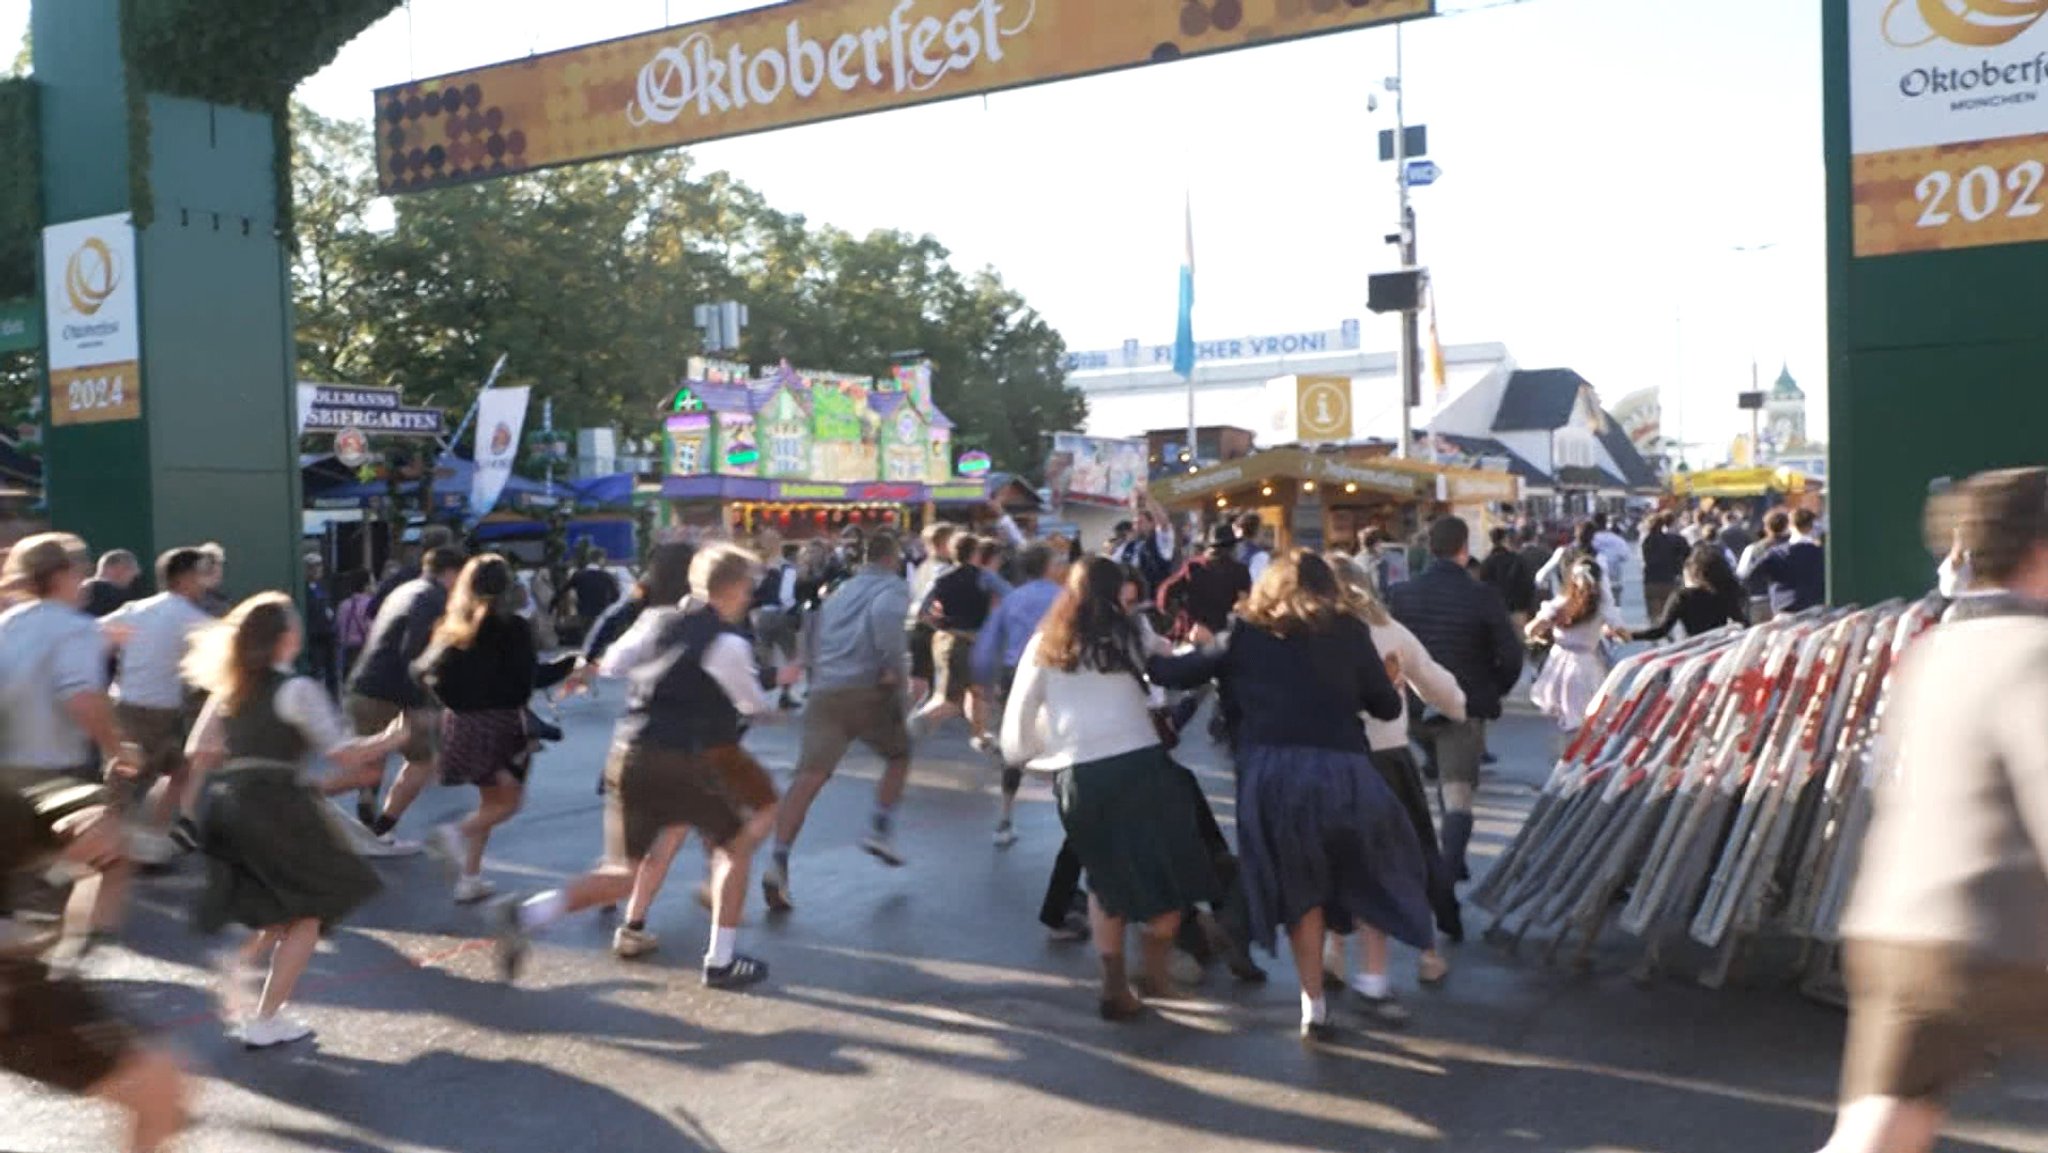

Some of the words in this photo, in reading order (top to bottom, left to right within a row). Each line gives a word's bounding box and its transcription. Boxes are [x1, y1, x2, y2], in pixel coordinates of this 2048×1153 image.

[627, 0, 1035, 126] Oktoberfest
[1250, 333, 1326, 355] VRONI
[68, 375, 123, 411] 2024
